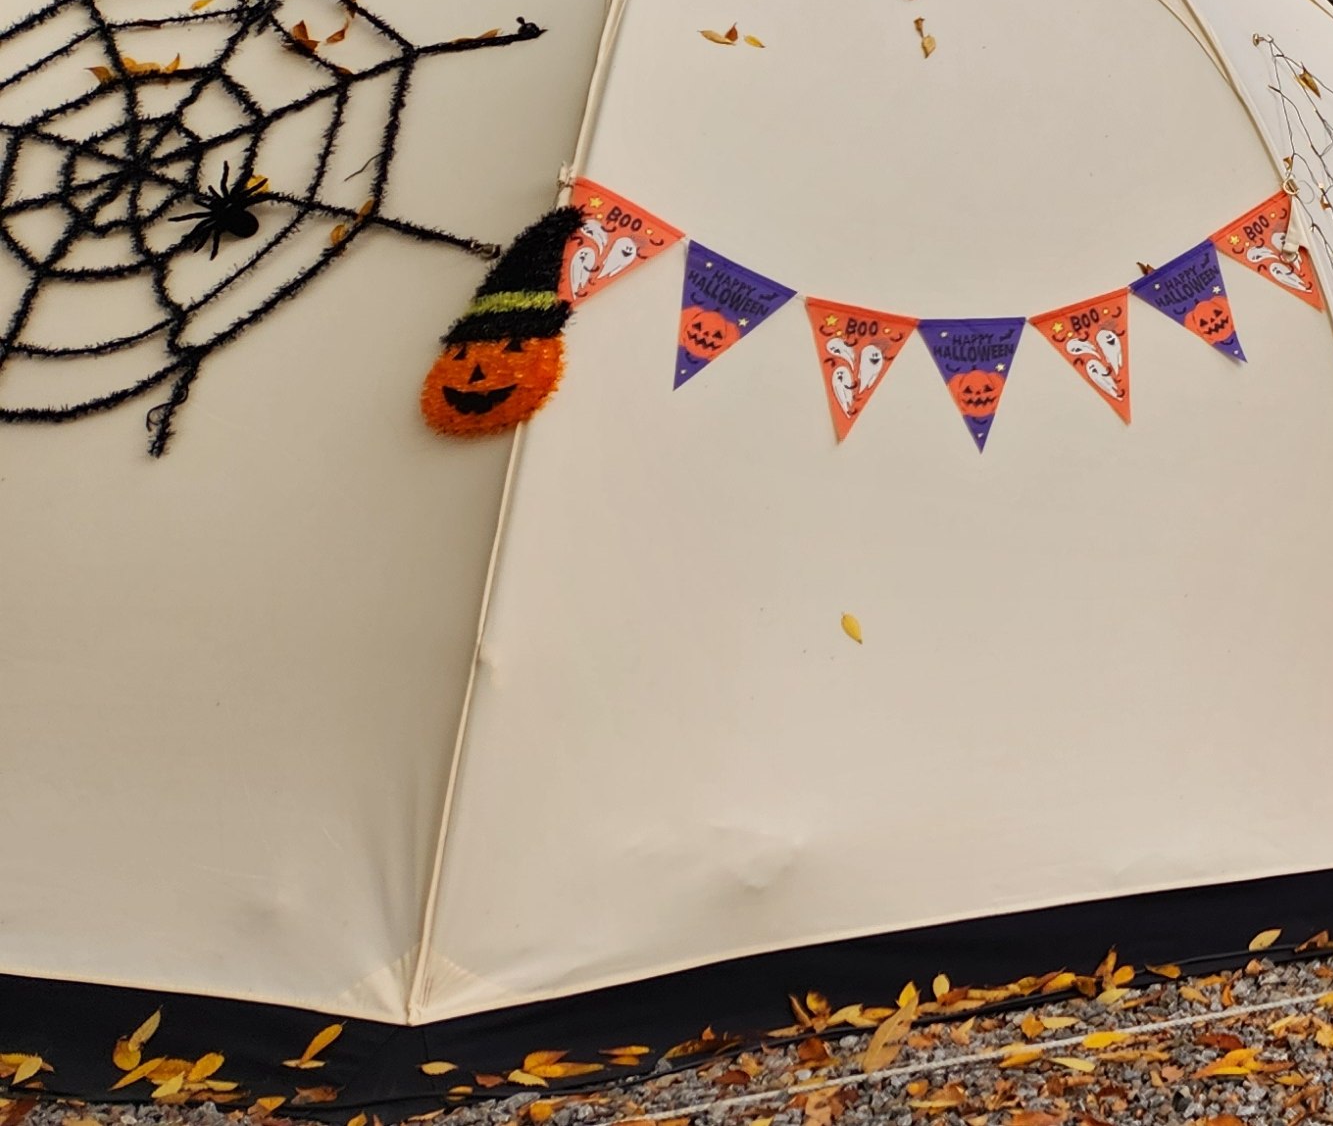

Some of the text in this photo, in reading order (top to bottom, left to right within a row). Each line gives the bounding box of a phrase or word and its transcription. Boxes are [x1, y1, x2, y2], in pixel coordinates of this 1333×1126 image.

[606, 206, 643, 232] BOO
[1242, 214, 1270, 241] BOO
[711, 269, 755, 295] HAPPY
[1154, 265, 1220, 309] HALLOWEEN
[1164, 264, 1199, 292] HAPPY
[688, 269, 770, 316] HALLOWEEN
[845, 318, 879, 337] BOO
[1070, 308, 1100, 332] BOO
[951, 333, 994, 346] HAPPY
[933, 344, 1015, 362] HALLOWEEN
